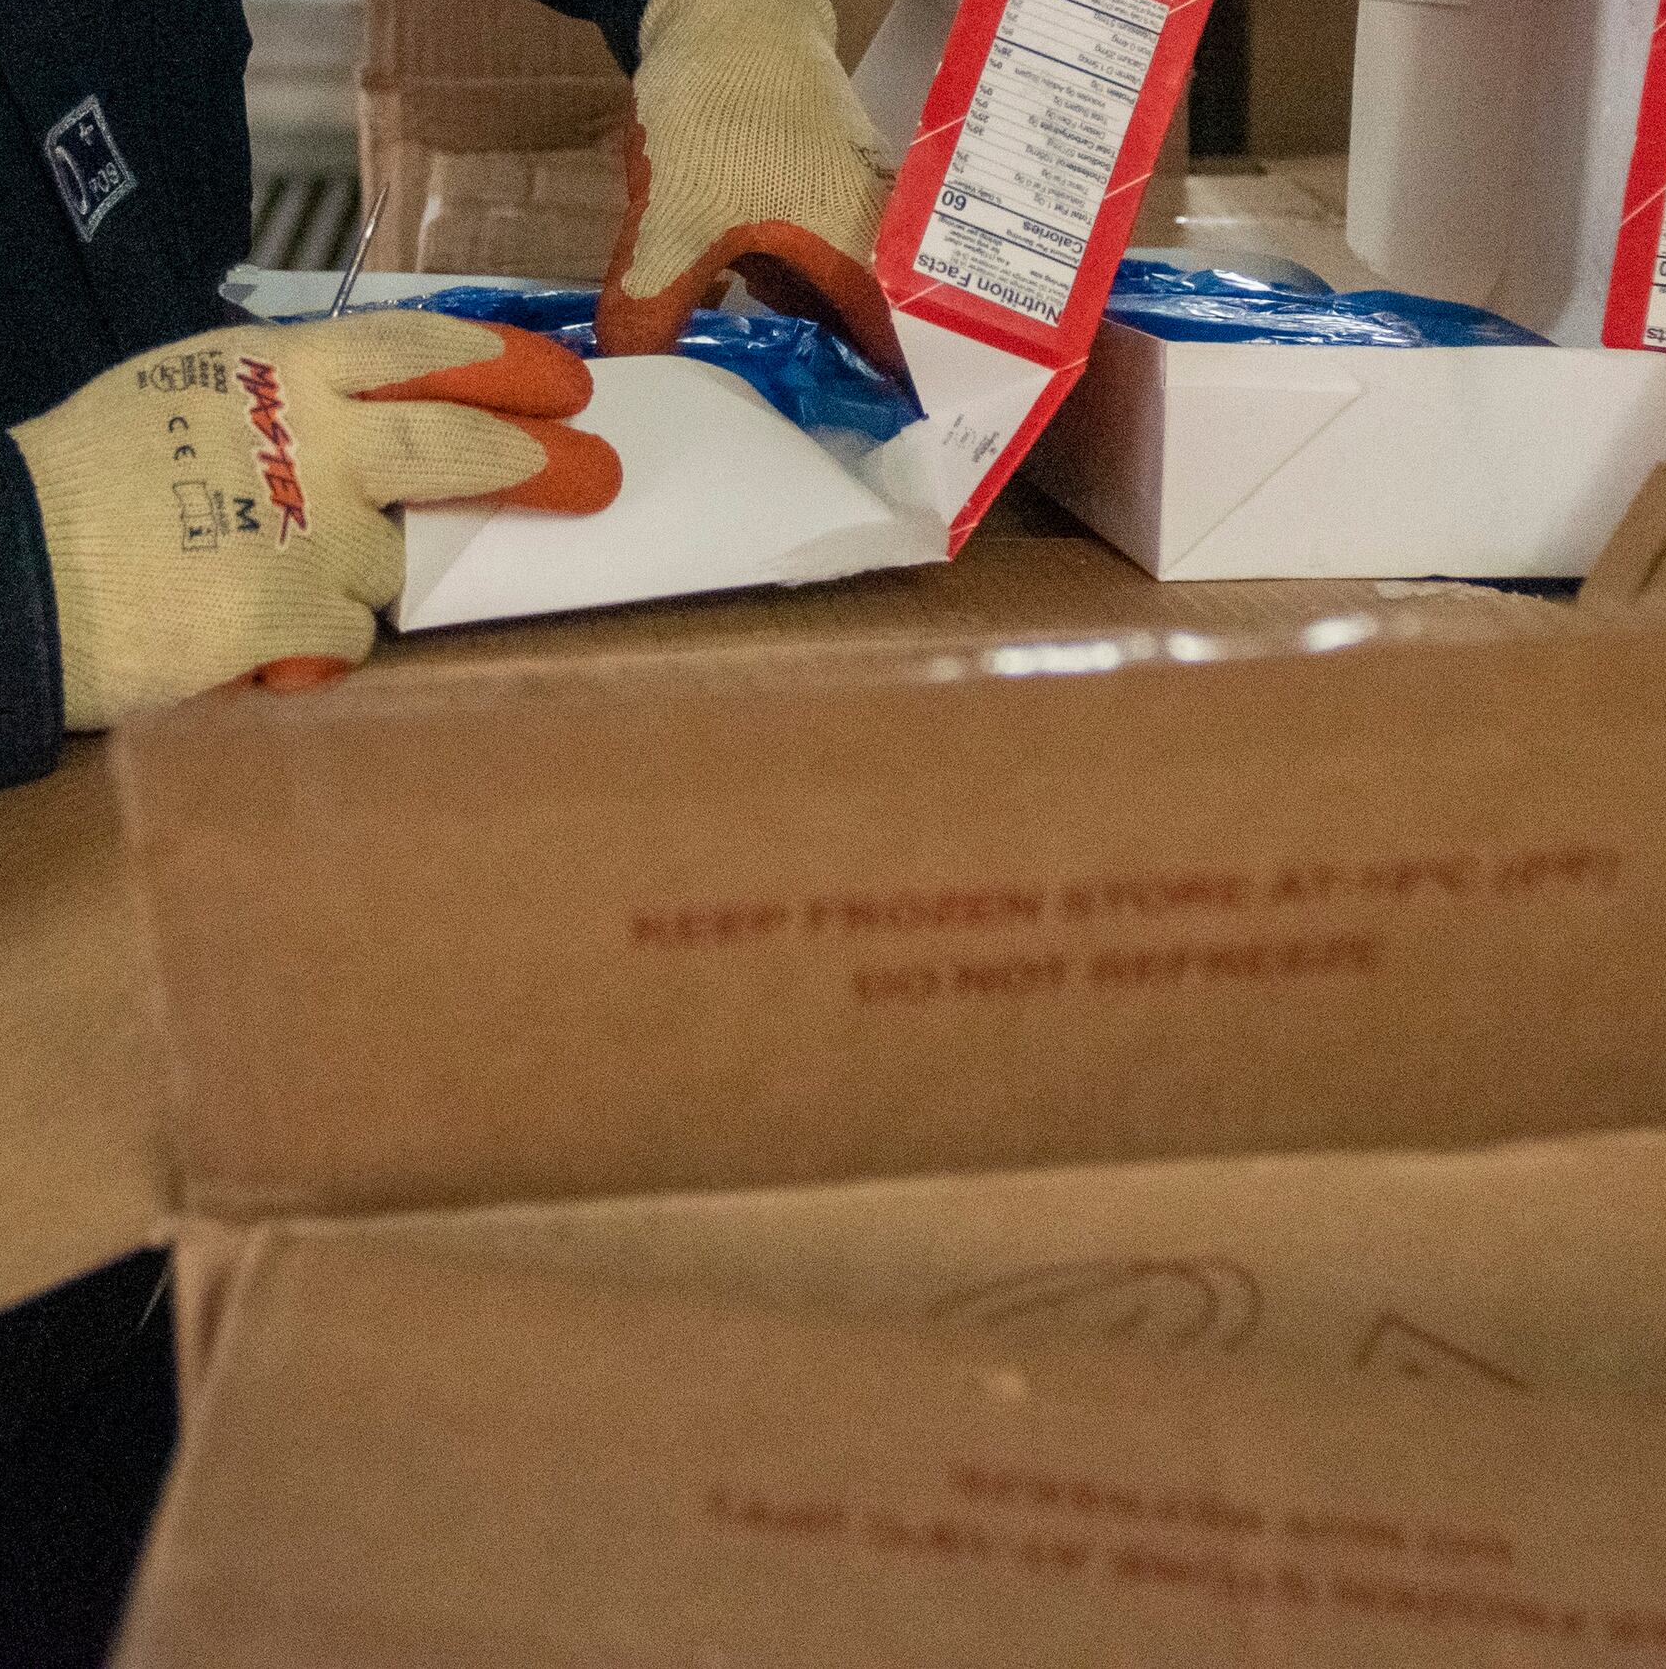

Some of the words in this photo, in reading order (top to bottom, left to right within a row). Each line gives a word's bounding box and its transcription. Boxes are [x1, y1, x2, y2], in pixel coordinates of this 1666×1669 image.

[1105, 86, 1135, 104] Protein
[1038, 119, 1096, 149] Carbohydrate
[1075, 151, 1112, 171] Sodium
[1094, 143, 1116, 158] Total
[1054, 156, 1108, 184] Cholesterol
[938, 188, 969, 213] 60
[1046, 186, 1086, 208] Saturated
[1053, 203, 1069, 215] Fat
[1069, 209, 1093, 225] Total
[1005, 228, 1034, 246] Serving
[1019, 219, 1085, 255] Calories
[914, 252, 973, 287] Facts
[1043, 274, 1070, 290] Serving
[973, 276, 1063, 324] Nutrition
[236, 356, 309, 545] MASTER
[233, 496, 261, 531] M
[953, 954, 1067, 998] NOT
